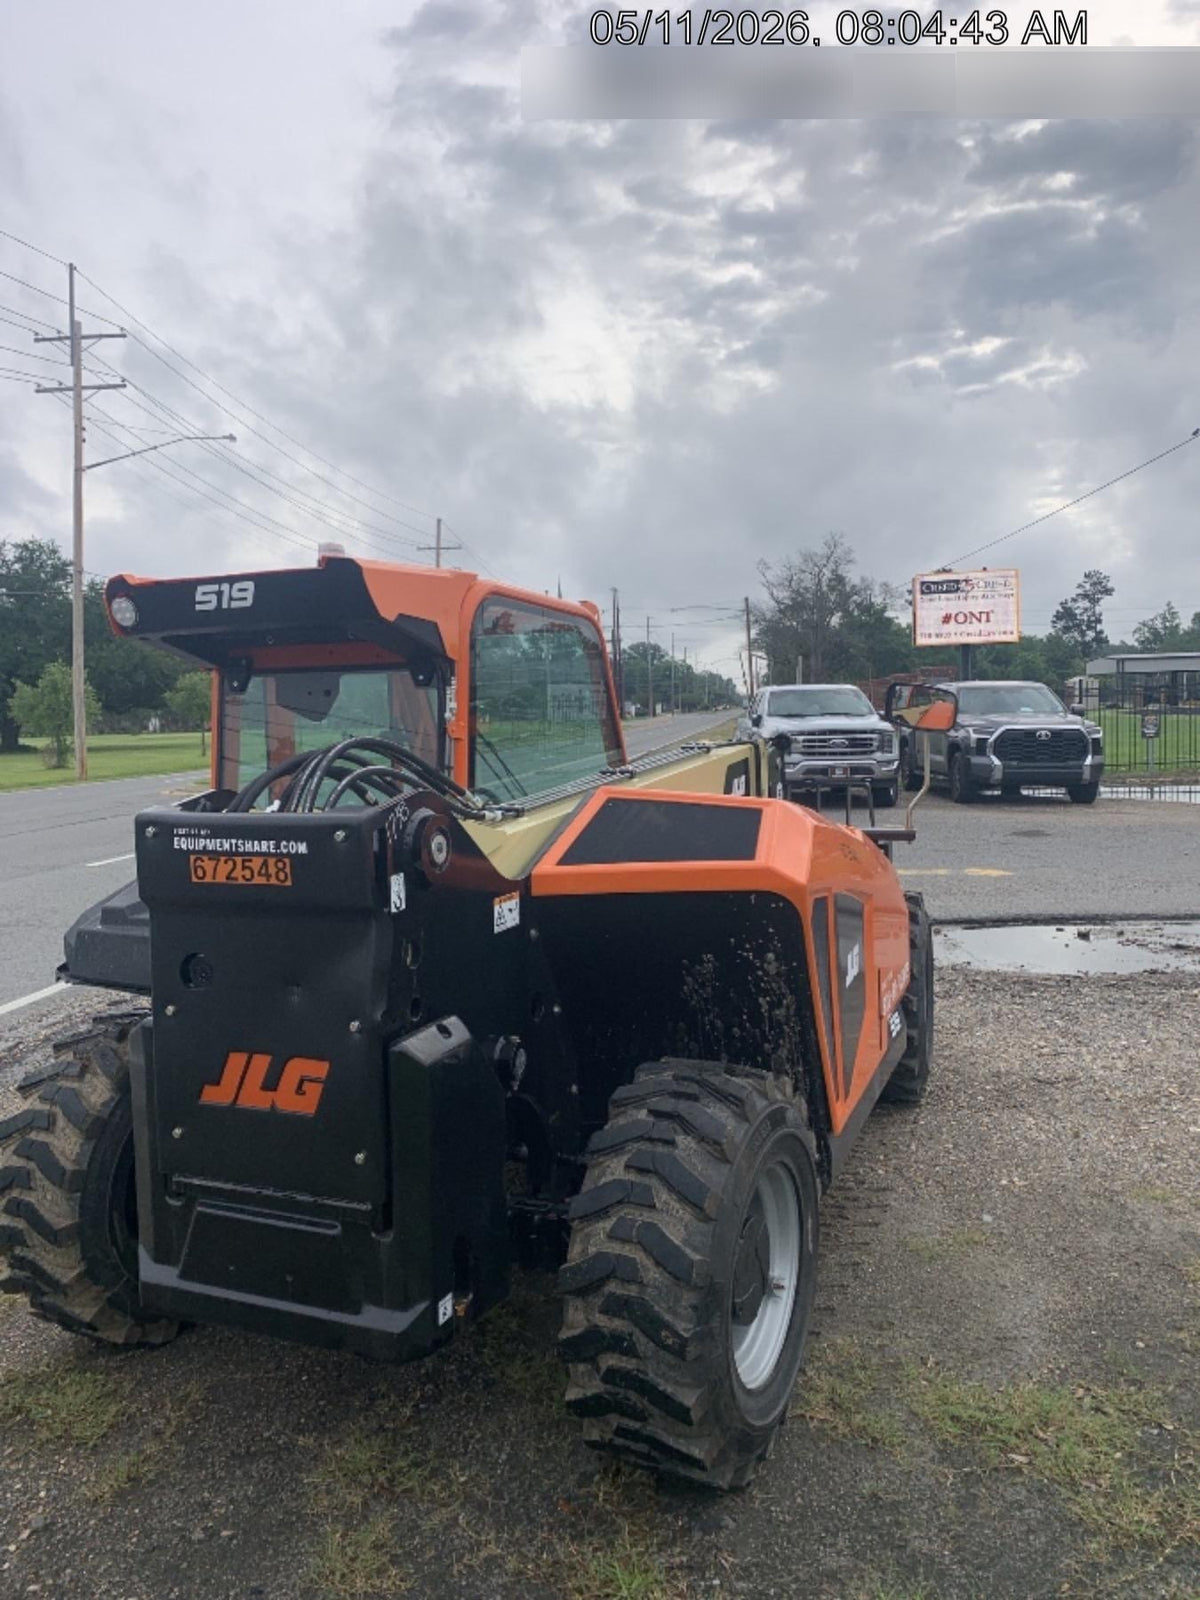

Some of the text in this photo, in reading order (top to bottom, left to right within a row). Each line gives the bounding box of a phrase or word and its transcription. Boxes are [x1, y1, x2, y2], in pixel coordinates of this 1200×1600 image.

[194, 580, 255, 611] 519
[173, 836, 308, 854] EQUIPMENTSHARE.COM
[193, 857, 289, 883] 672548
[199, 1051, 330, 1117] JLG
